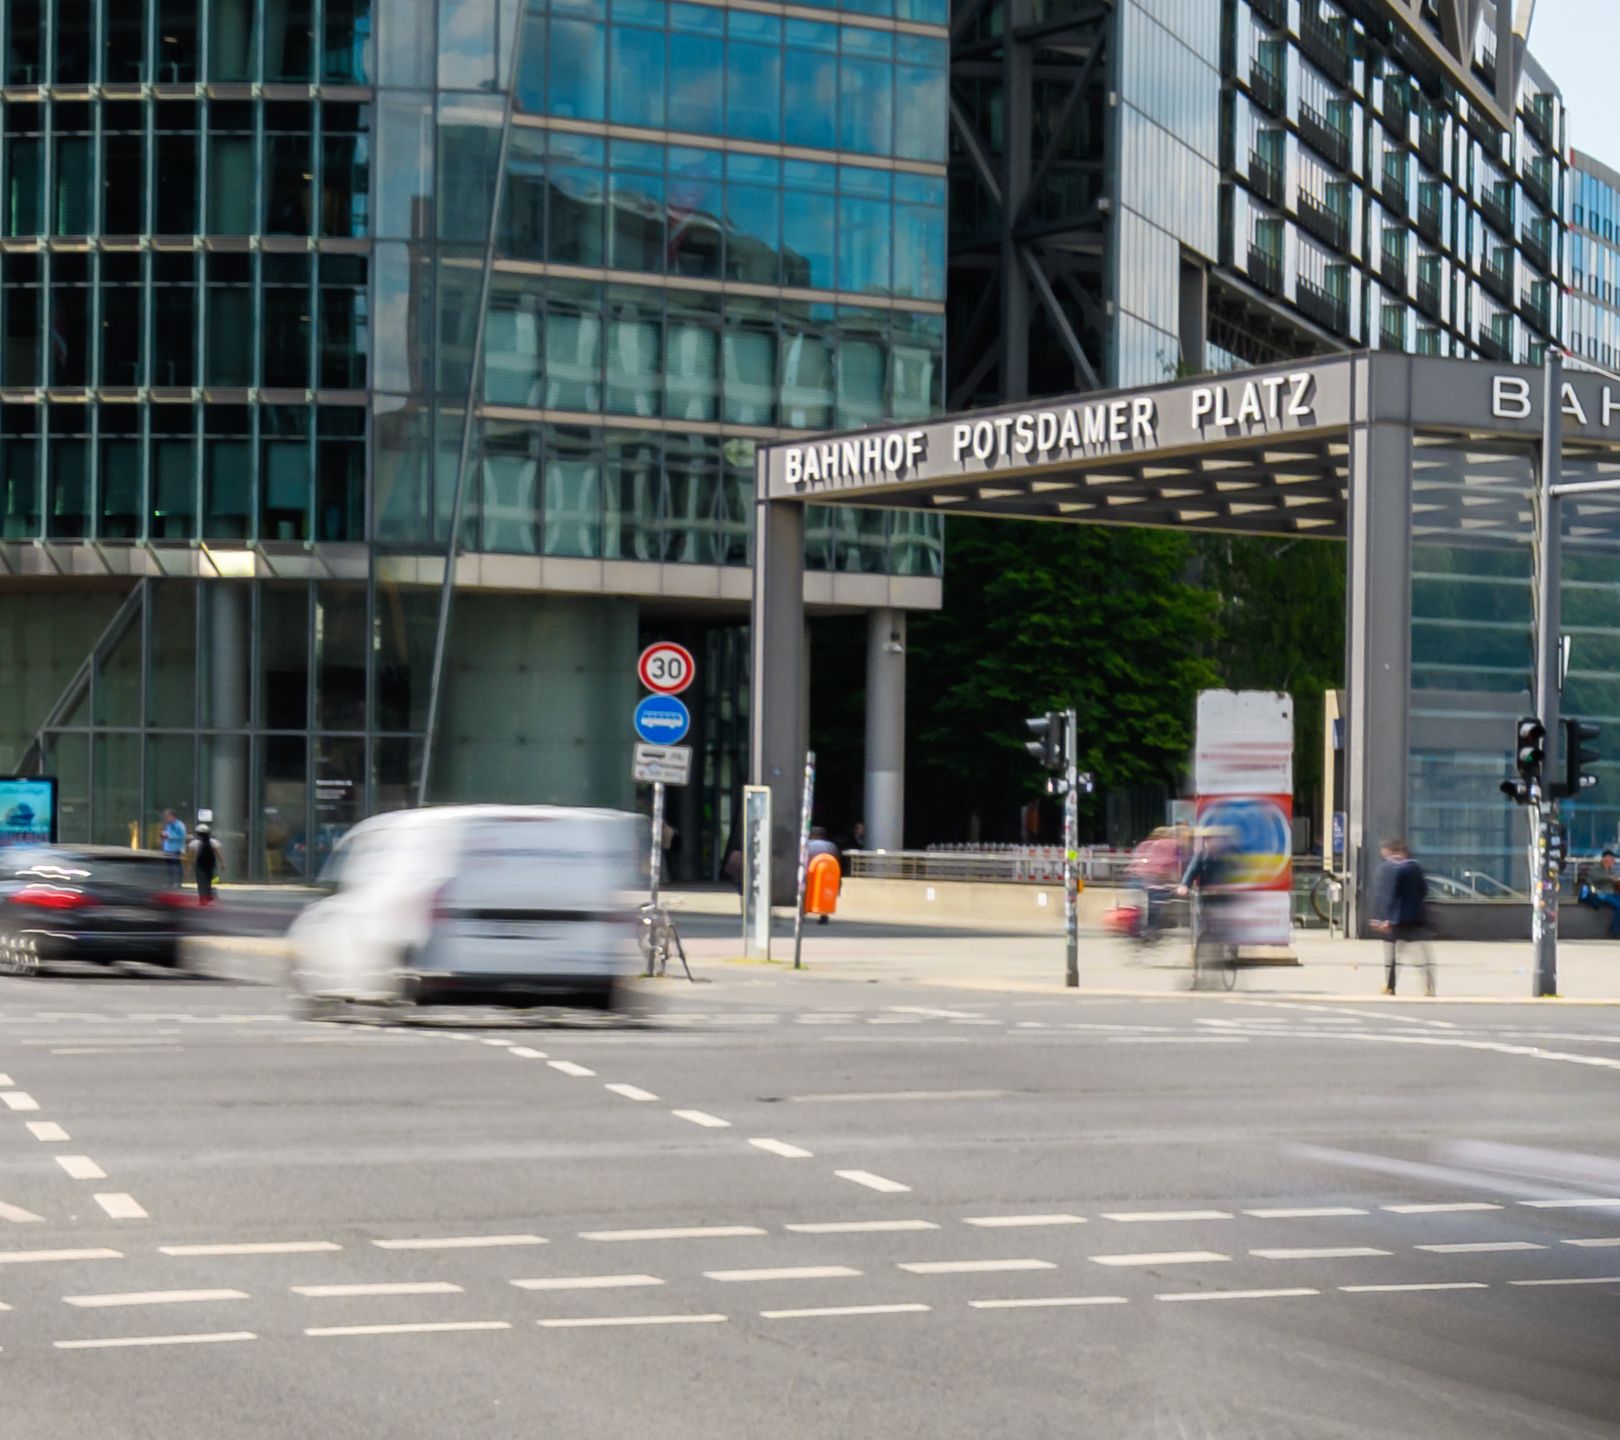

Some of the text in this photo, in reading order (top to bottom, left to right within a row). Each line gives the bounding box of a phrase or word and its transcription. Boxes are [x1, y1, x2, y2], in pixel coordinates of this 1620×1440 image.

[786, 373, 1312, 483] BAHNHOF POTSDAMER PLATZ
[652, 658, 682, 679] 30
